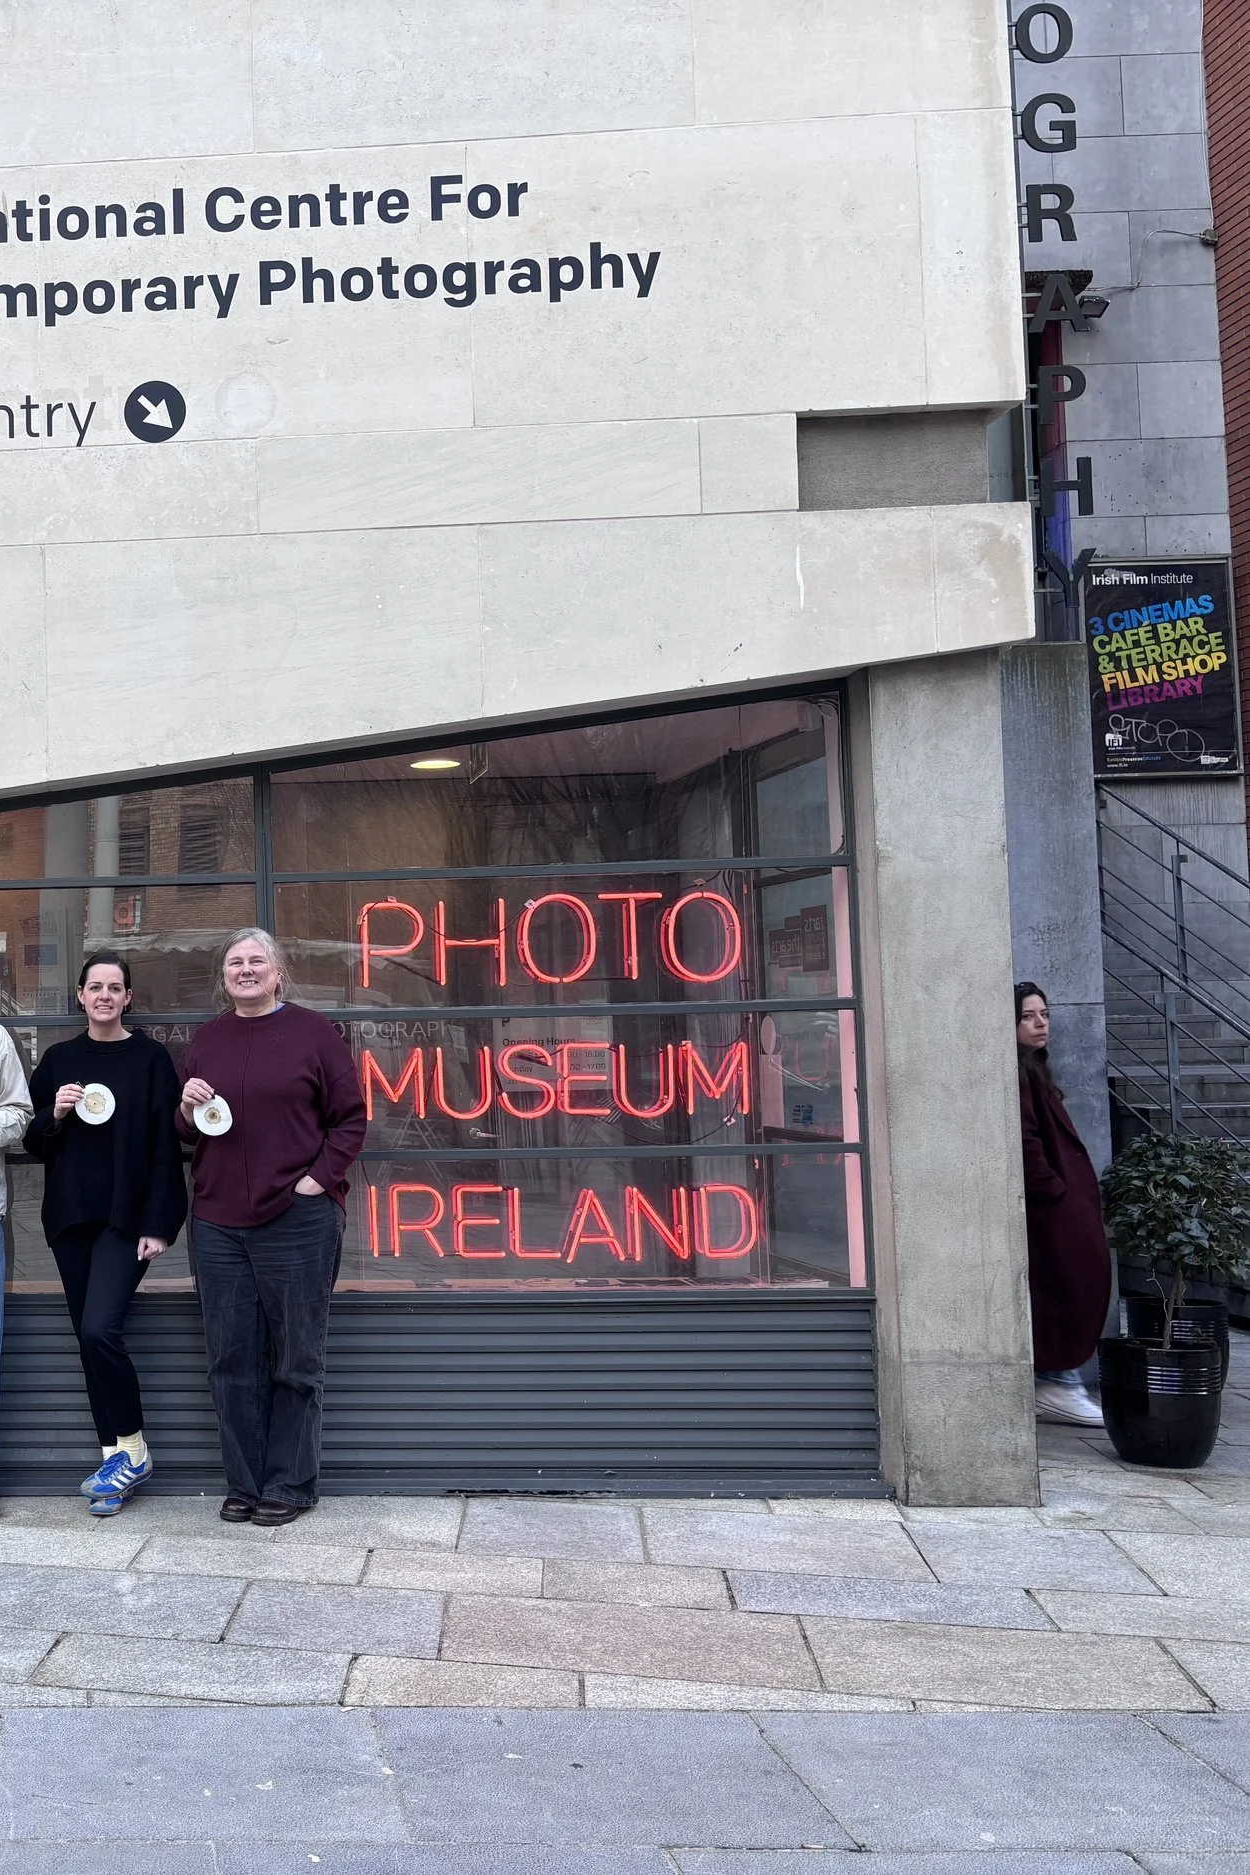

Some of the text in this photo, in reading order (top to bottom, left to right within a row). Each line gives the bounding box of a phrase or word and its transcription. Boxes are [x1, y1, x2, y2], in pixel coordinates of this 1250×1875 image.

[205, 183, 410, 232] Centre
[430, 174, 528, 221] For
[259, 242, 661, 308] Photography
[1092, 572, 1194, 586] Irish Film Institute
[1089, 594, 1215, 636] 3 CINEMAS
[1092, 617, 1207, 655] CAFÉ BAR
[1098, 631, 1226, 674] & TERRACE
[1101, 651, 1227, 693] FILM SHOP
[1106, 674, 1205, 711] LIBRARY
[359, 891, 742, 988] PHOTO
[152, 1025, 192, 1043] GAL
[362, 1041, 750, 1121] MUSEUM
[366, 1183, 759, 1264] IRELAND
